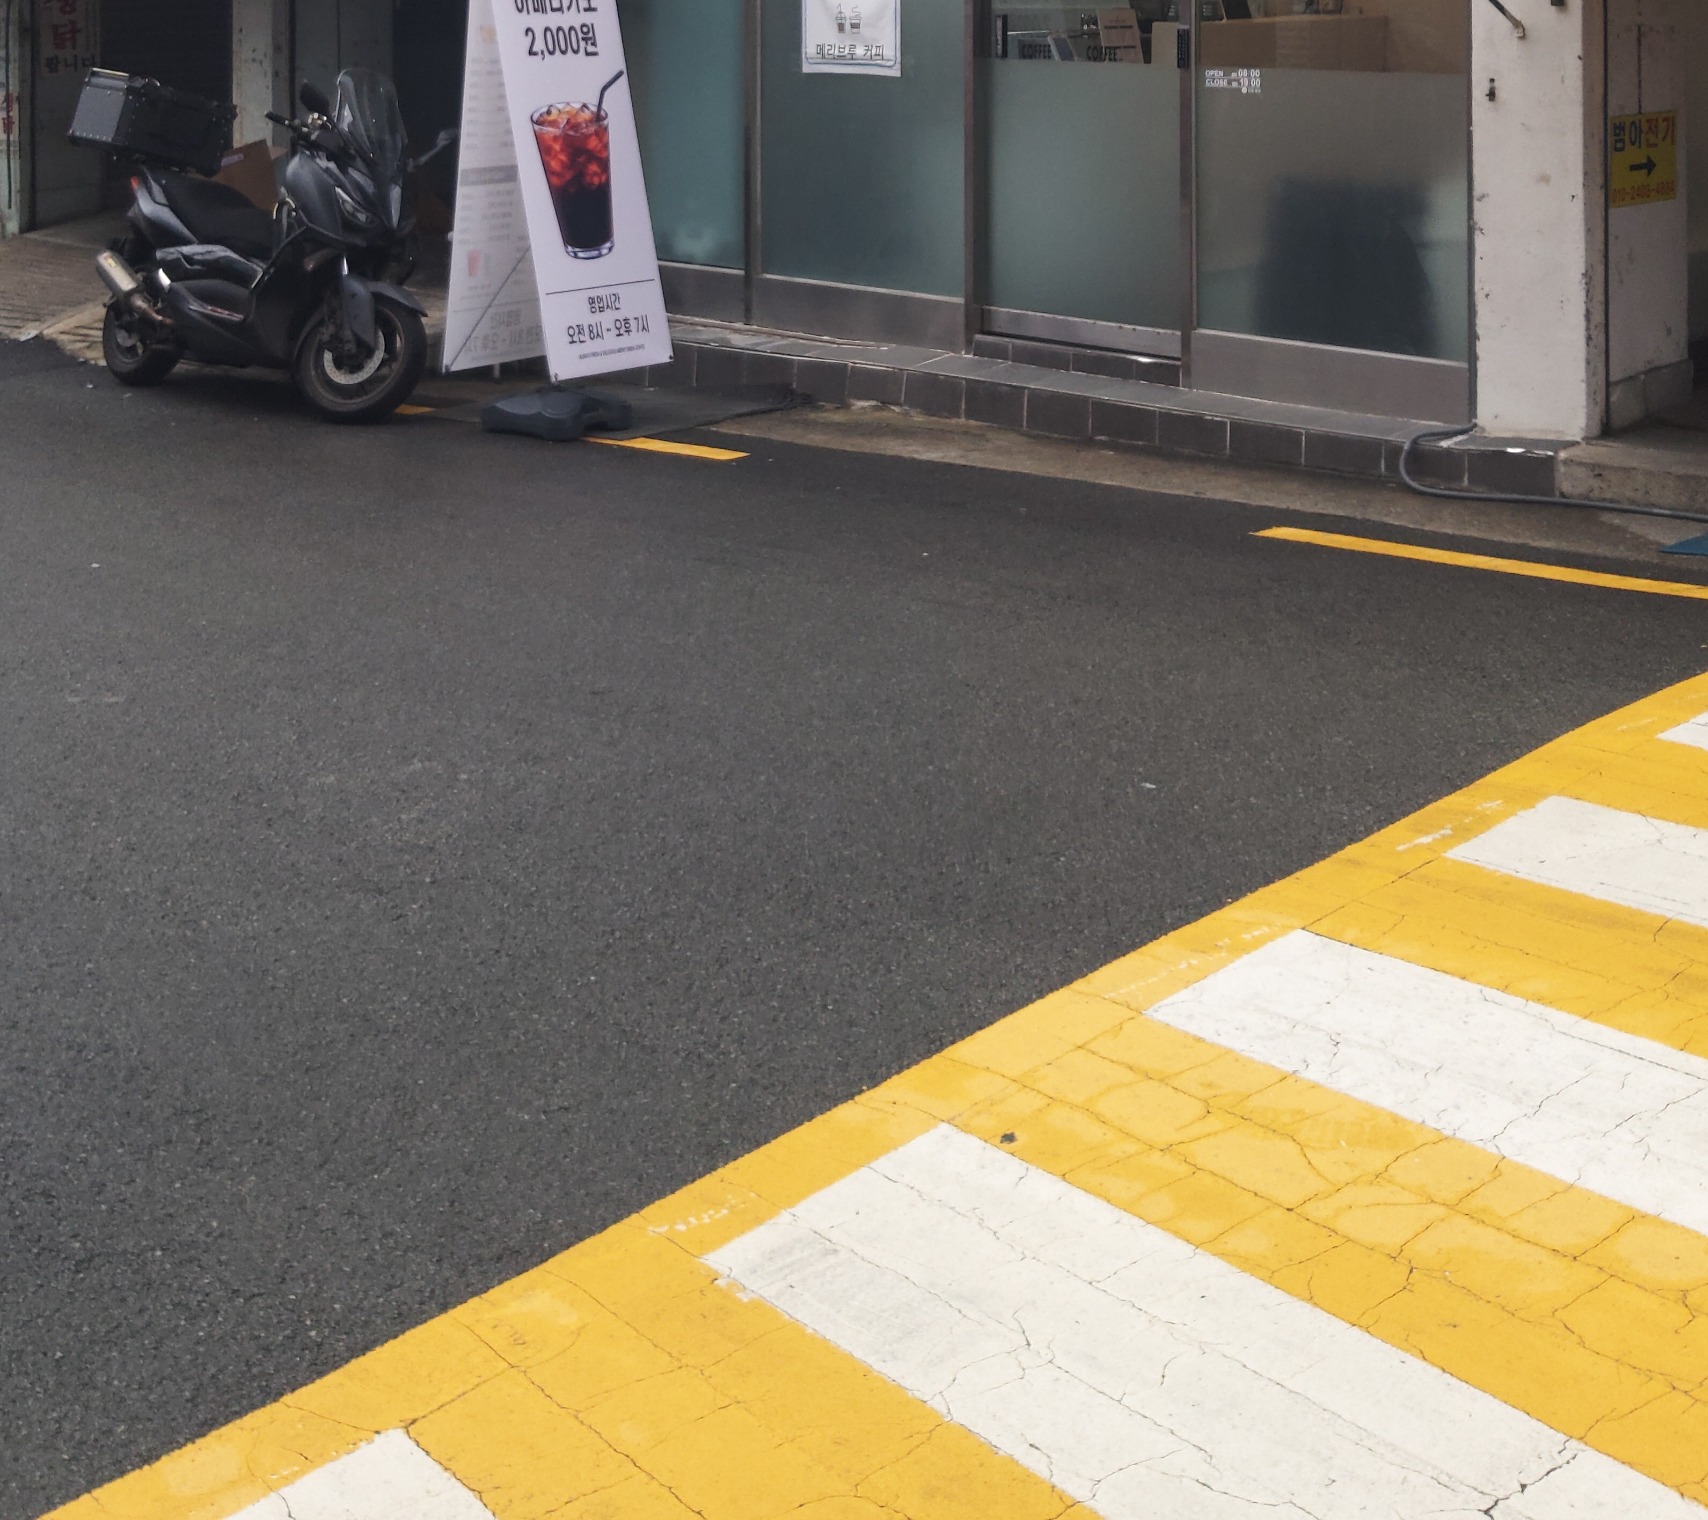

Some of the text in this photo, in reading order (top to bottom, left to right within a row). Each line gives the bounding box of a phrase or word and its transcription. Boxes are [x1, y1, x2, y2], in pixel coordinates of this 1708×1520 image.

[524, 22, 600, 61] 2,000원
[816, 42, 885, 60] 메리브루 커피
[588, 292, 621, 314] 영업시간
[567, 323, 586, 344] 오전
[614, 316, 632, 337] 오후
